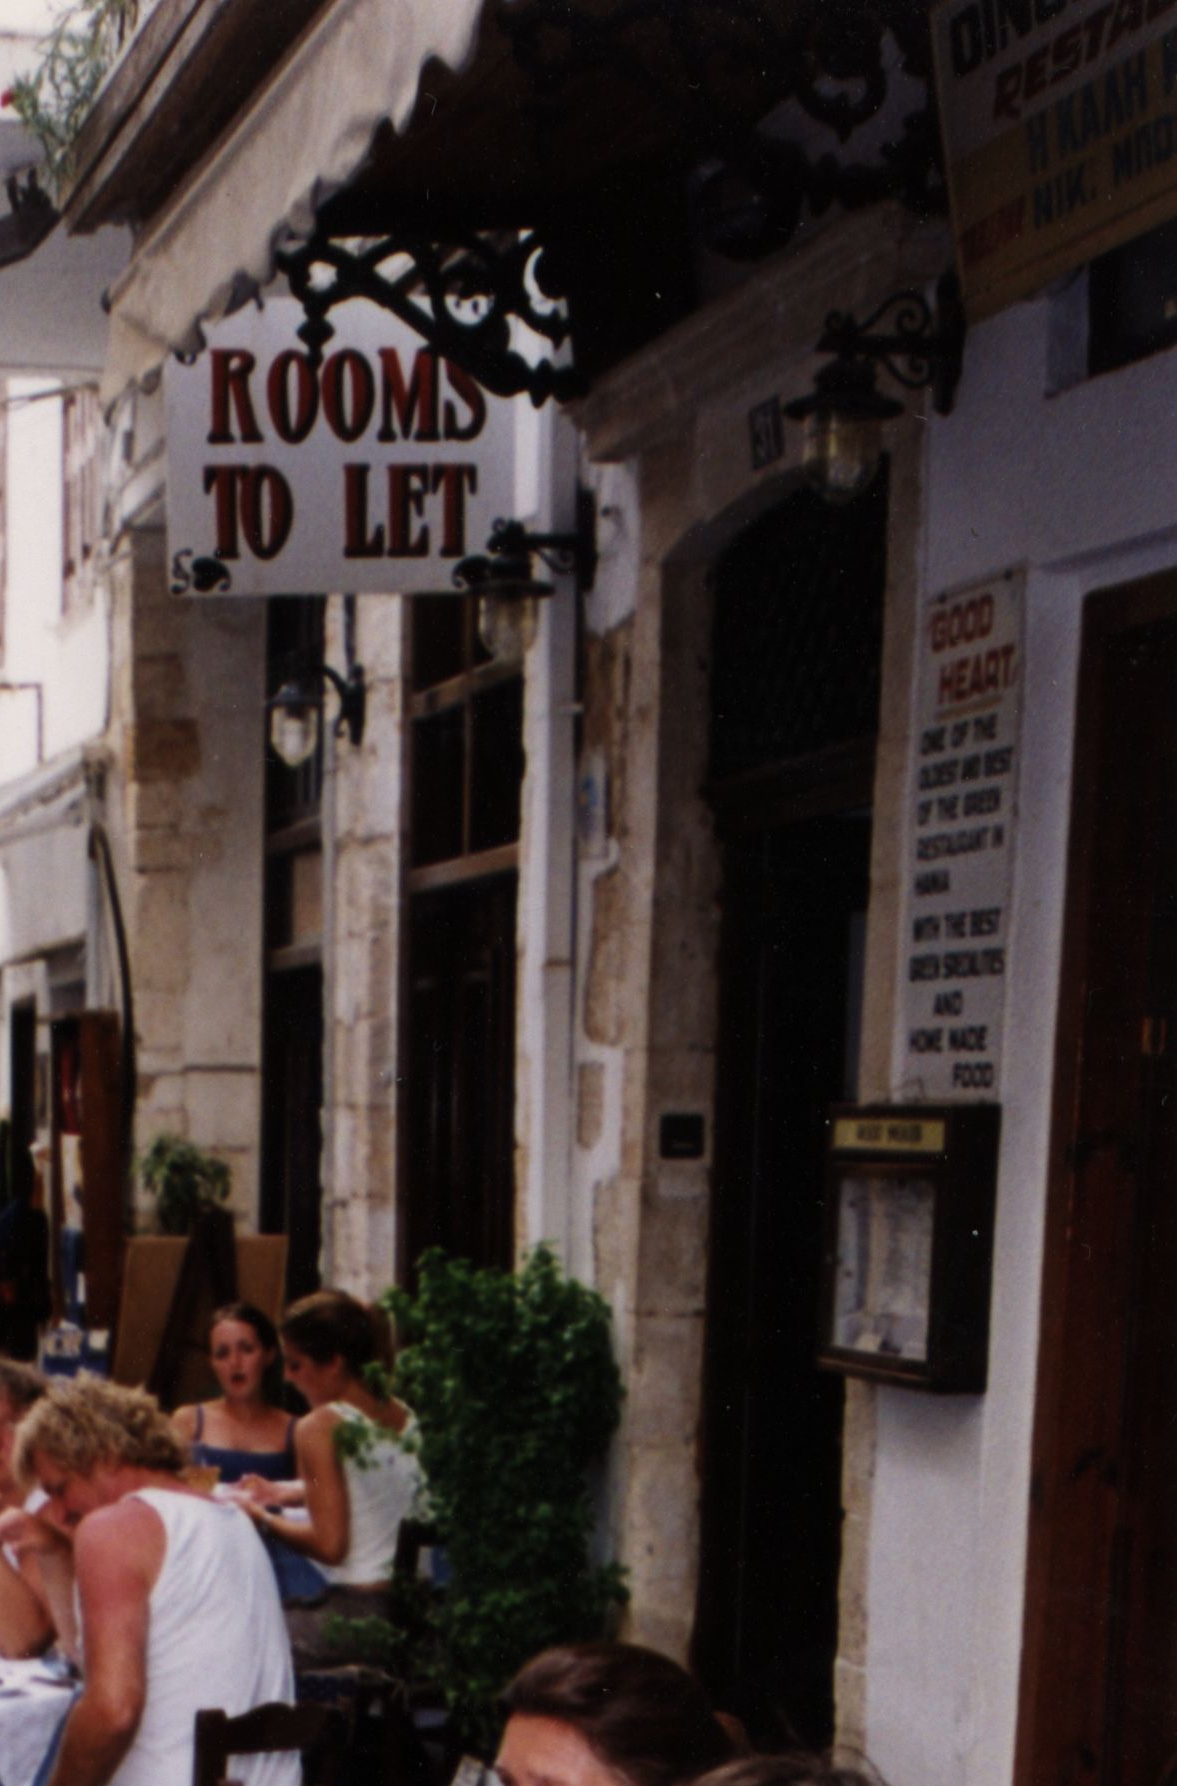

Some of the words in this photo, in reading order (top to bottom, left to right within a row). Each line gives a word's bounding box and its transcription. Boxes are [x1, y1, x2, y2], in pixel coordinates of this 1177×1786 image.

[207, 347, 486, 444] ROOMS
[203, 464, 294, 560] TO
[343, 464, 477, 559] LET
[930, 594, 994, 653] GOOD
[937, 643, 1015, 704] HEART
[920, 726, 946, 755] ONE
[950, 720, 969, 748] OF
[973, 712, 998, 741] THE
[983, 746, 1014, 778] BEST
[937, 794, 960, 821] THE
[944, 911, 967, 940] THE
[969, 907, 1002, 938] BEST
[934, 989, 963, 1017] AND
[910, 1026, 944, 1054] HOME
[949, 1024, 988, 1053] MADE
[953, 1061, 994, 1089] FOOD
